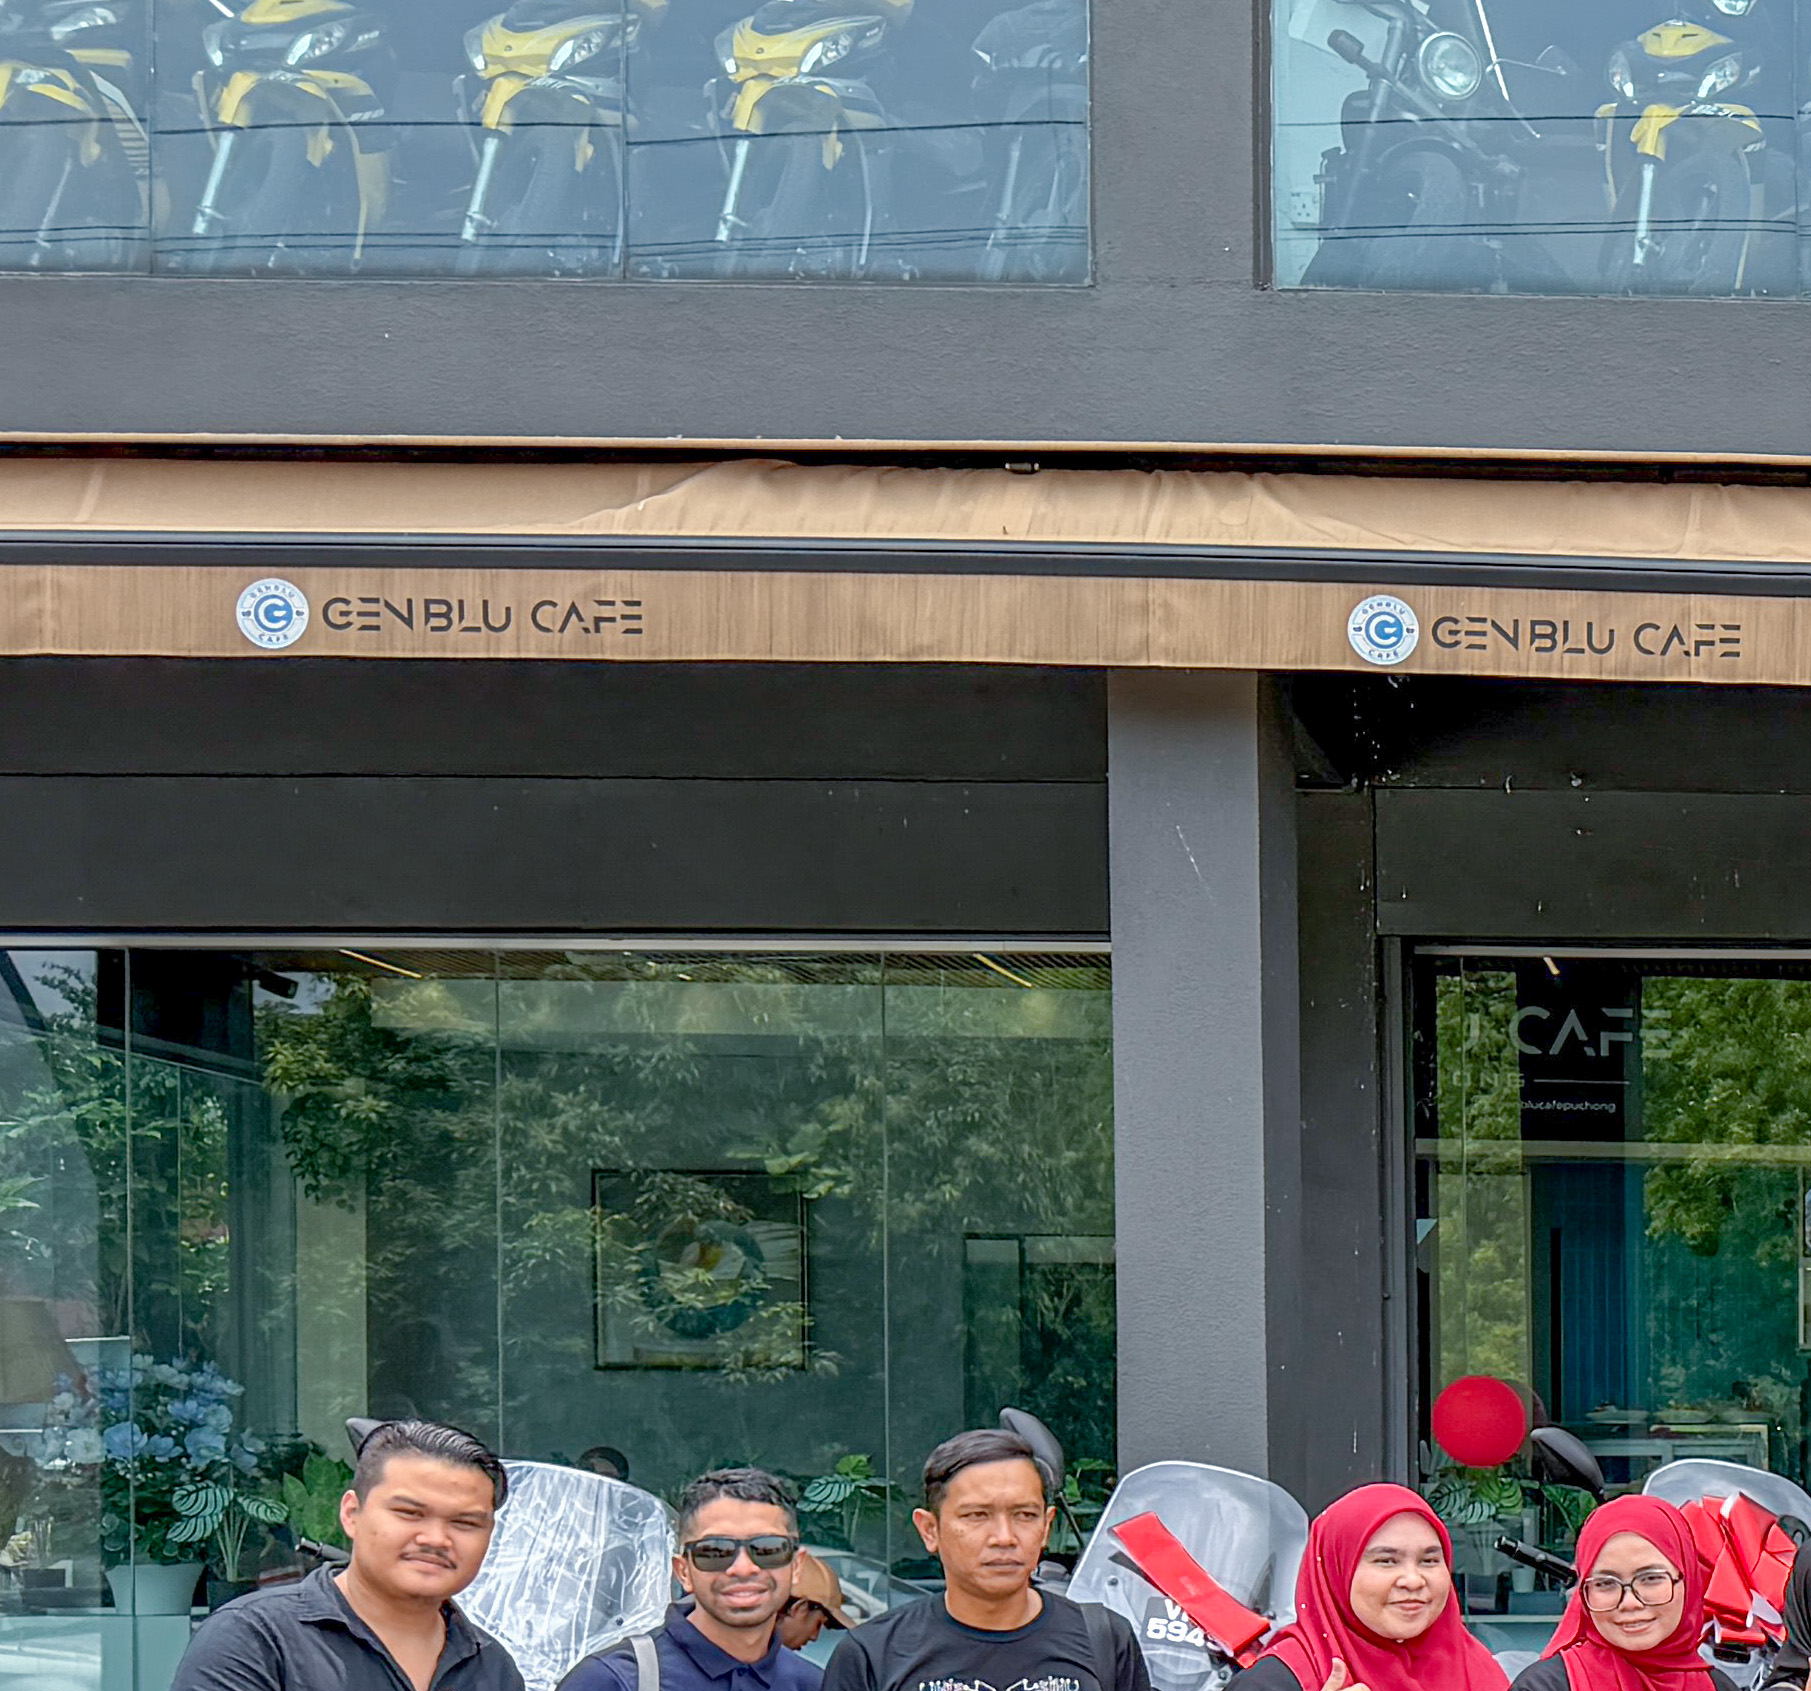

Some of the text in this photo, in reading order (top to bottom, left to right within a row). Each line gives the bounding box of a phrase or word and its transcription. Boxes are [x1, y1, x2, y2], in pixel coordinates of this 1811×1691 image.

[322, 596, 643, 634] GENBLU CAFE
[1432, 616, 1740, 657] GENBLU CAFE
[1509, 1005, 1672, 1059] CAFE
